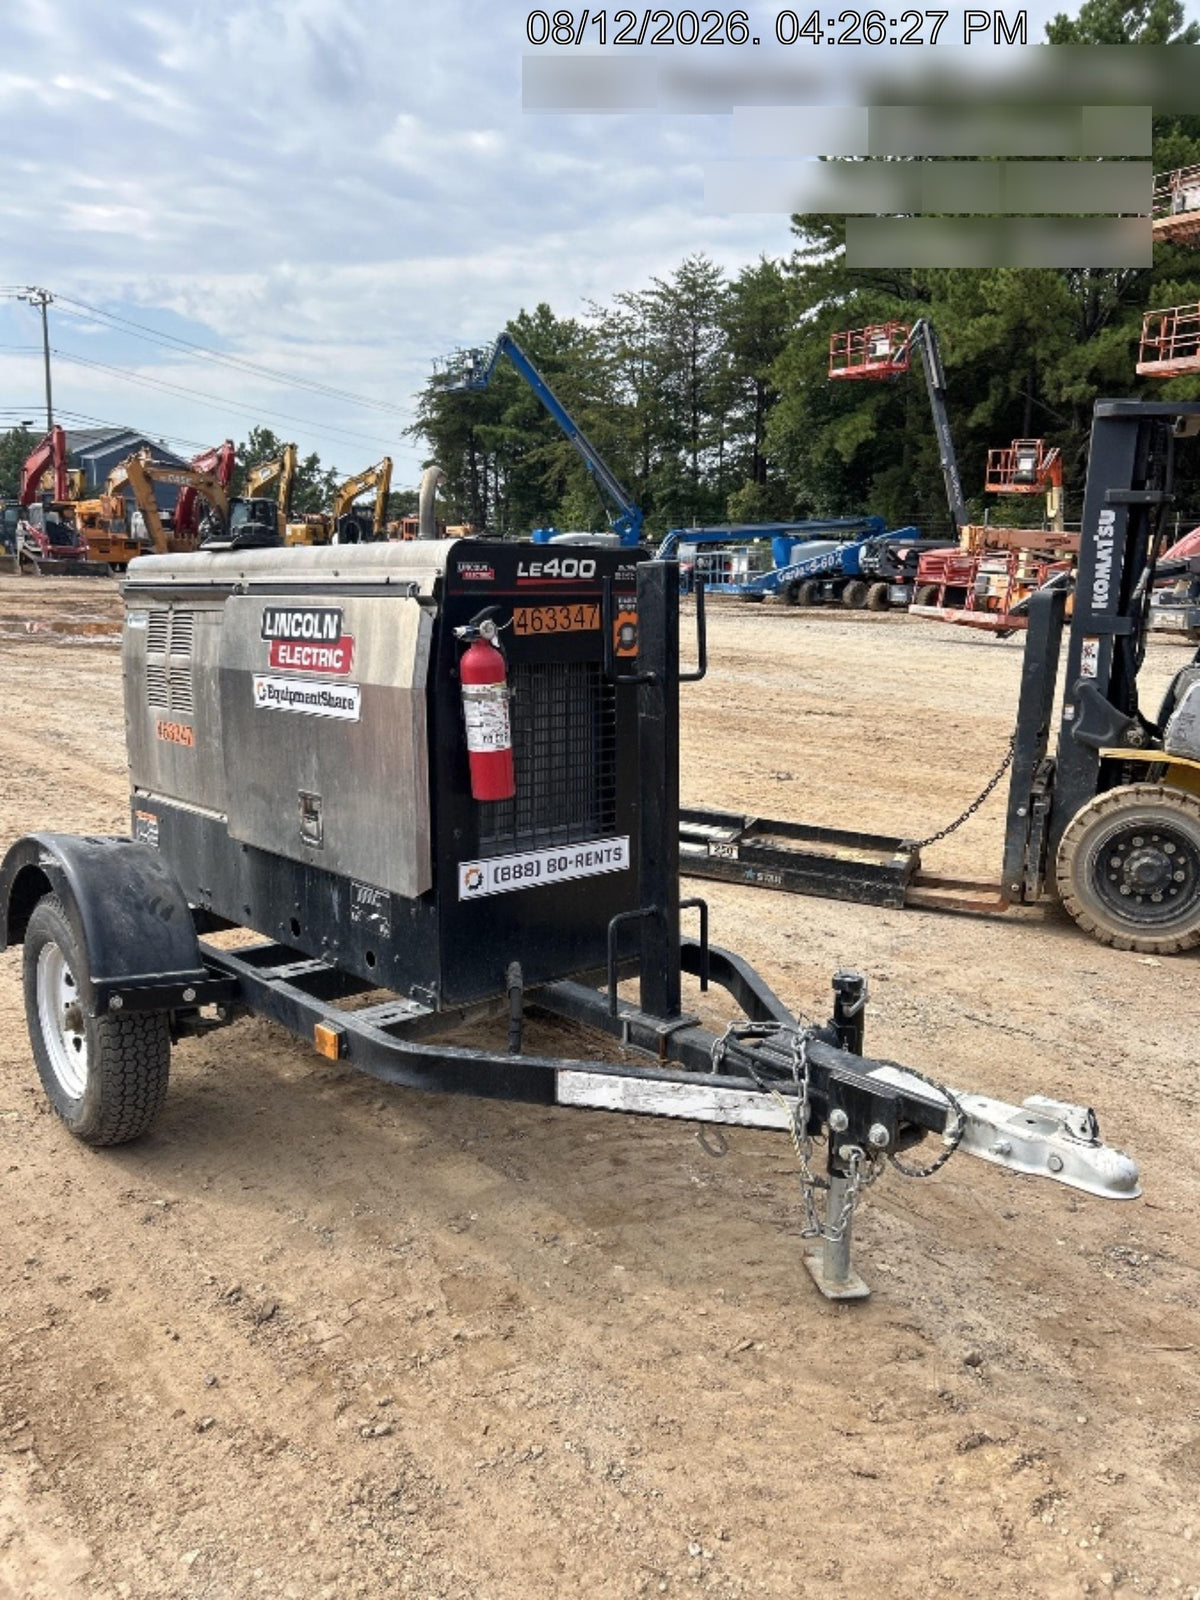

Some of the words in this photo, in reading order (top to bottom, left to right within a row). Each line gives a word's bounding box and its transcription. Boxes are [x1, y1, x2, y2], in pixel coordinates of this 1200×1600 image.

[516, 558, 596, 578] LE400
[1091, 509, 1116, 610] KOMATSU
[264, 612, 339, 639] LINCOLN
[516, 605, 598, 633] 463347
[278, 645, 344, 668] ELECTRIC
[266, 684, 355, 710] EquipmentShare
[493, 860, 541, 884] (888)
[546, 847, 623, 874] 80-RENTS
